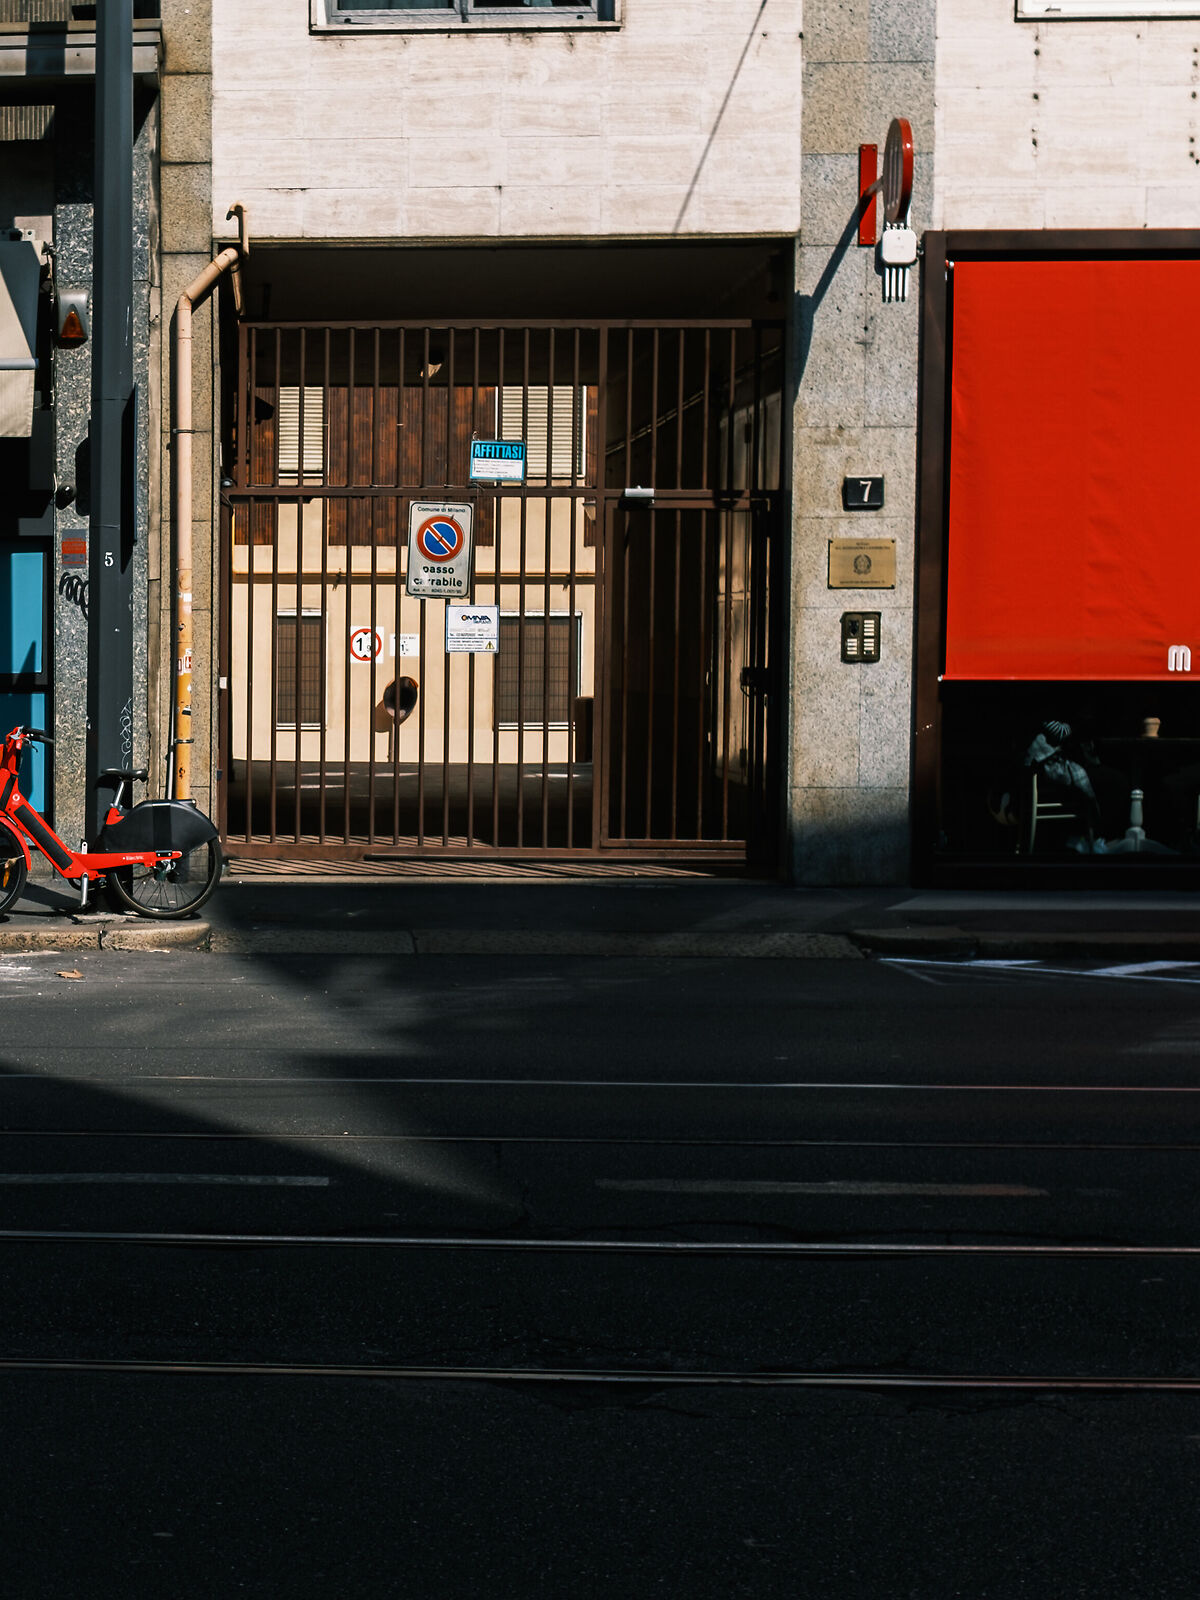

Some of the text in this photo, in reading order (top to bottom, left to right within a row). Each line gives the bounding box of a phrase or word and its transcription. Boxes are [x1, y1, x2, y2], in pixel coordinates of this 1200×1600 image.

[474, 444, 523, 459] AFFITTASI
[859, 480, 873, 502] 7
[104, 552, 114, 567] 5
[413, 577, 463, 587] crabile
